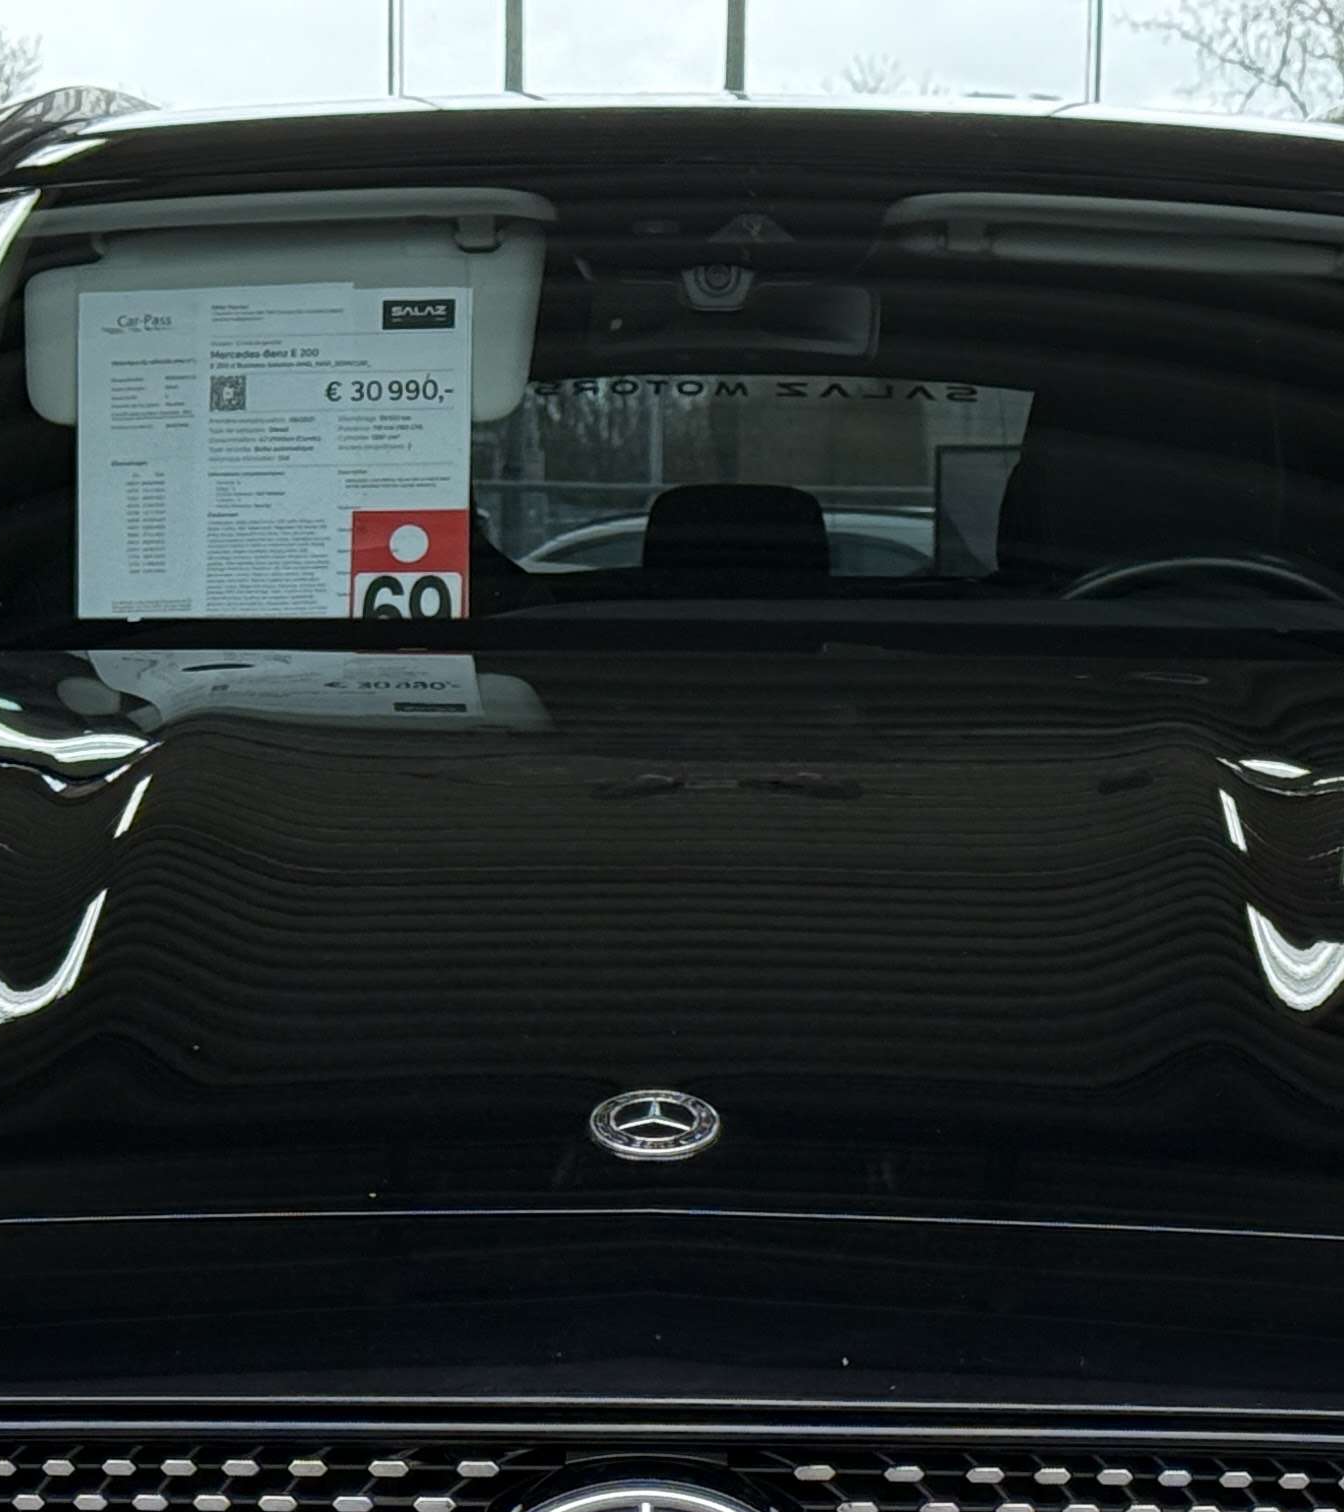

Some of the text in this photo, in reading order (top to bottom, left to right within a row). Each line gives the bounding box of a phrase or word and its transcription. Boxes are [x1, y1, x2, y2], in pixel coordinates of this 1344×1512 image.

[391, 305, 448, 317] SALAZ
[116, 314, 173, 328] Car-Pass
[325, 381, 343, 402] €
